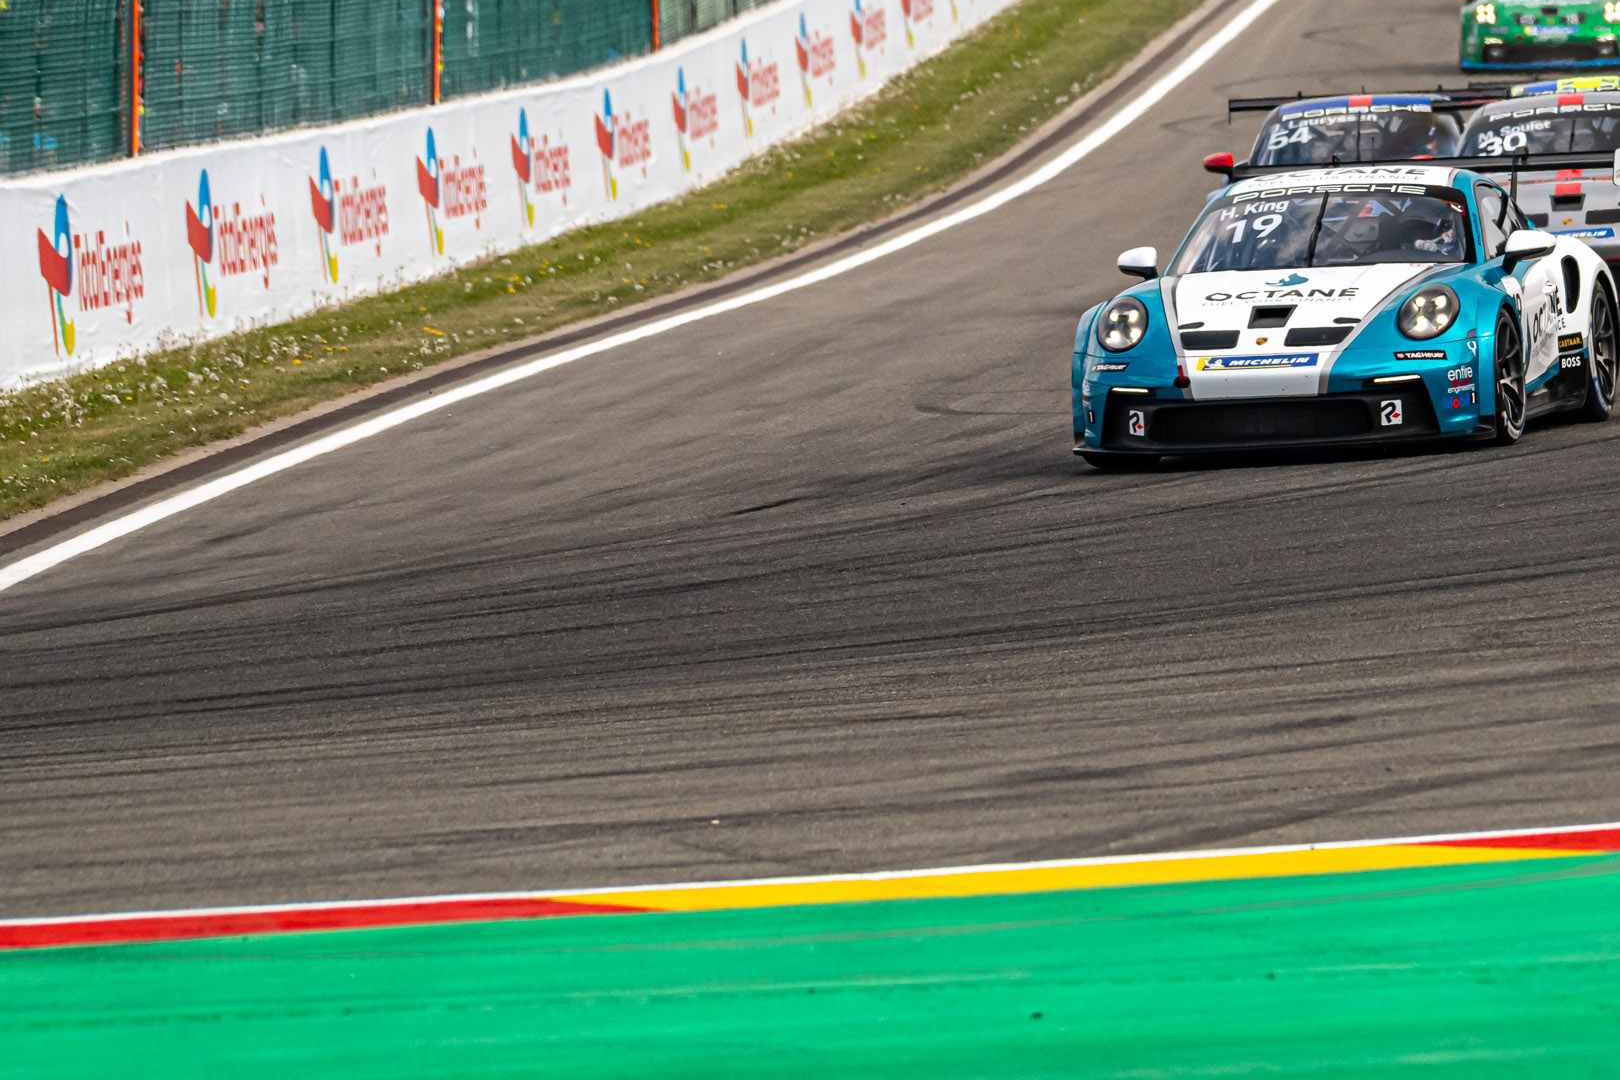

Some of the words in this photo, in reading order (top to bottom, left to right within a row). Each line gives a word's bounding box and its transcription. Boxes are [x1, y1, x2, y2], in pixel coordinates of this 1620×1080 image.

[1282, 105, 1432, 121] PORSCHE
[1267, 126, 1313, 150] 54
[1500, 119, 1551, 137] Soulet
[1477, 132, 1528, 156] 30
[1232, 184, 1427, 205] PORSCHE
[1219, 208, 1239, 222] H.
[1244, 200, 1290, 215] King
[1226, 214, 1284, 244] 19
[213, 192, 278, 290] TotalEnergies
[73, 219, 144, 325] TotalEnergies
[1205, 287, 1360, 302] OCTANE
[1228, 356, 1311, 366] MICHELIN
[1561, 356, 1581, 369] BOSS
[1447, 365, 1473, 381] entire
